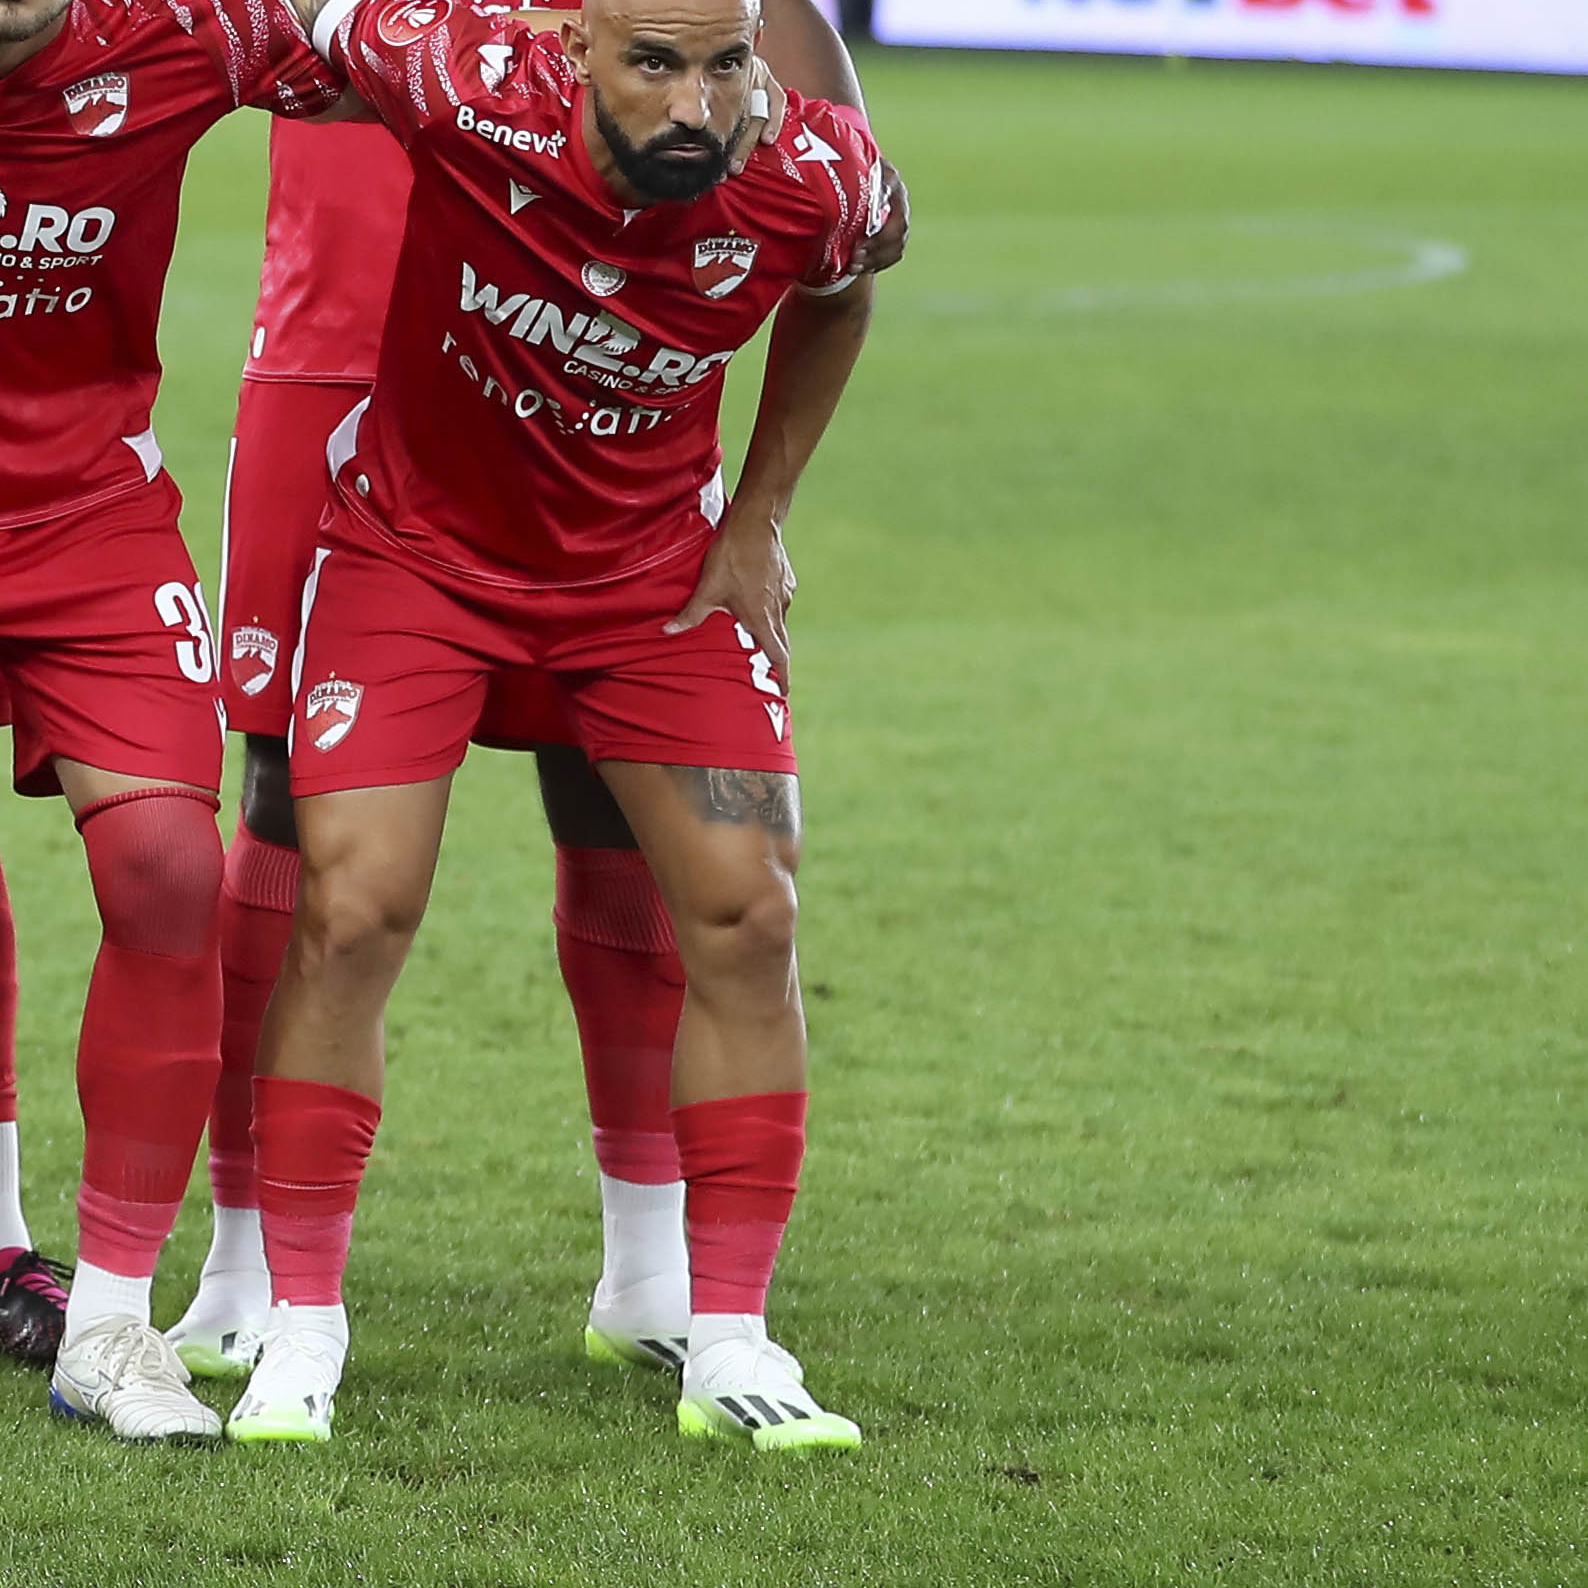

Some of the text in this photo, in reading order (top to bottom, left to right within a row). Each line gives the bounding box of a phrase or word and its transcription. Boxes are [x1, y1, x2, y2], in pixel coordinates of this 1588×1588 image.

[65, 77, 125, 100] DINAMO
[457, 105, 560, 159] Beneva
[19, 252, 33, 269] &
[37, 253, 104, 270] SPORT
[563, 359, 634, 391] CASINO
[154, 581, 220, 684] 3
[235, 633, 276, 651] DINAMO
